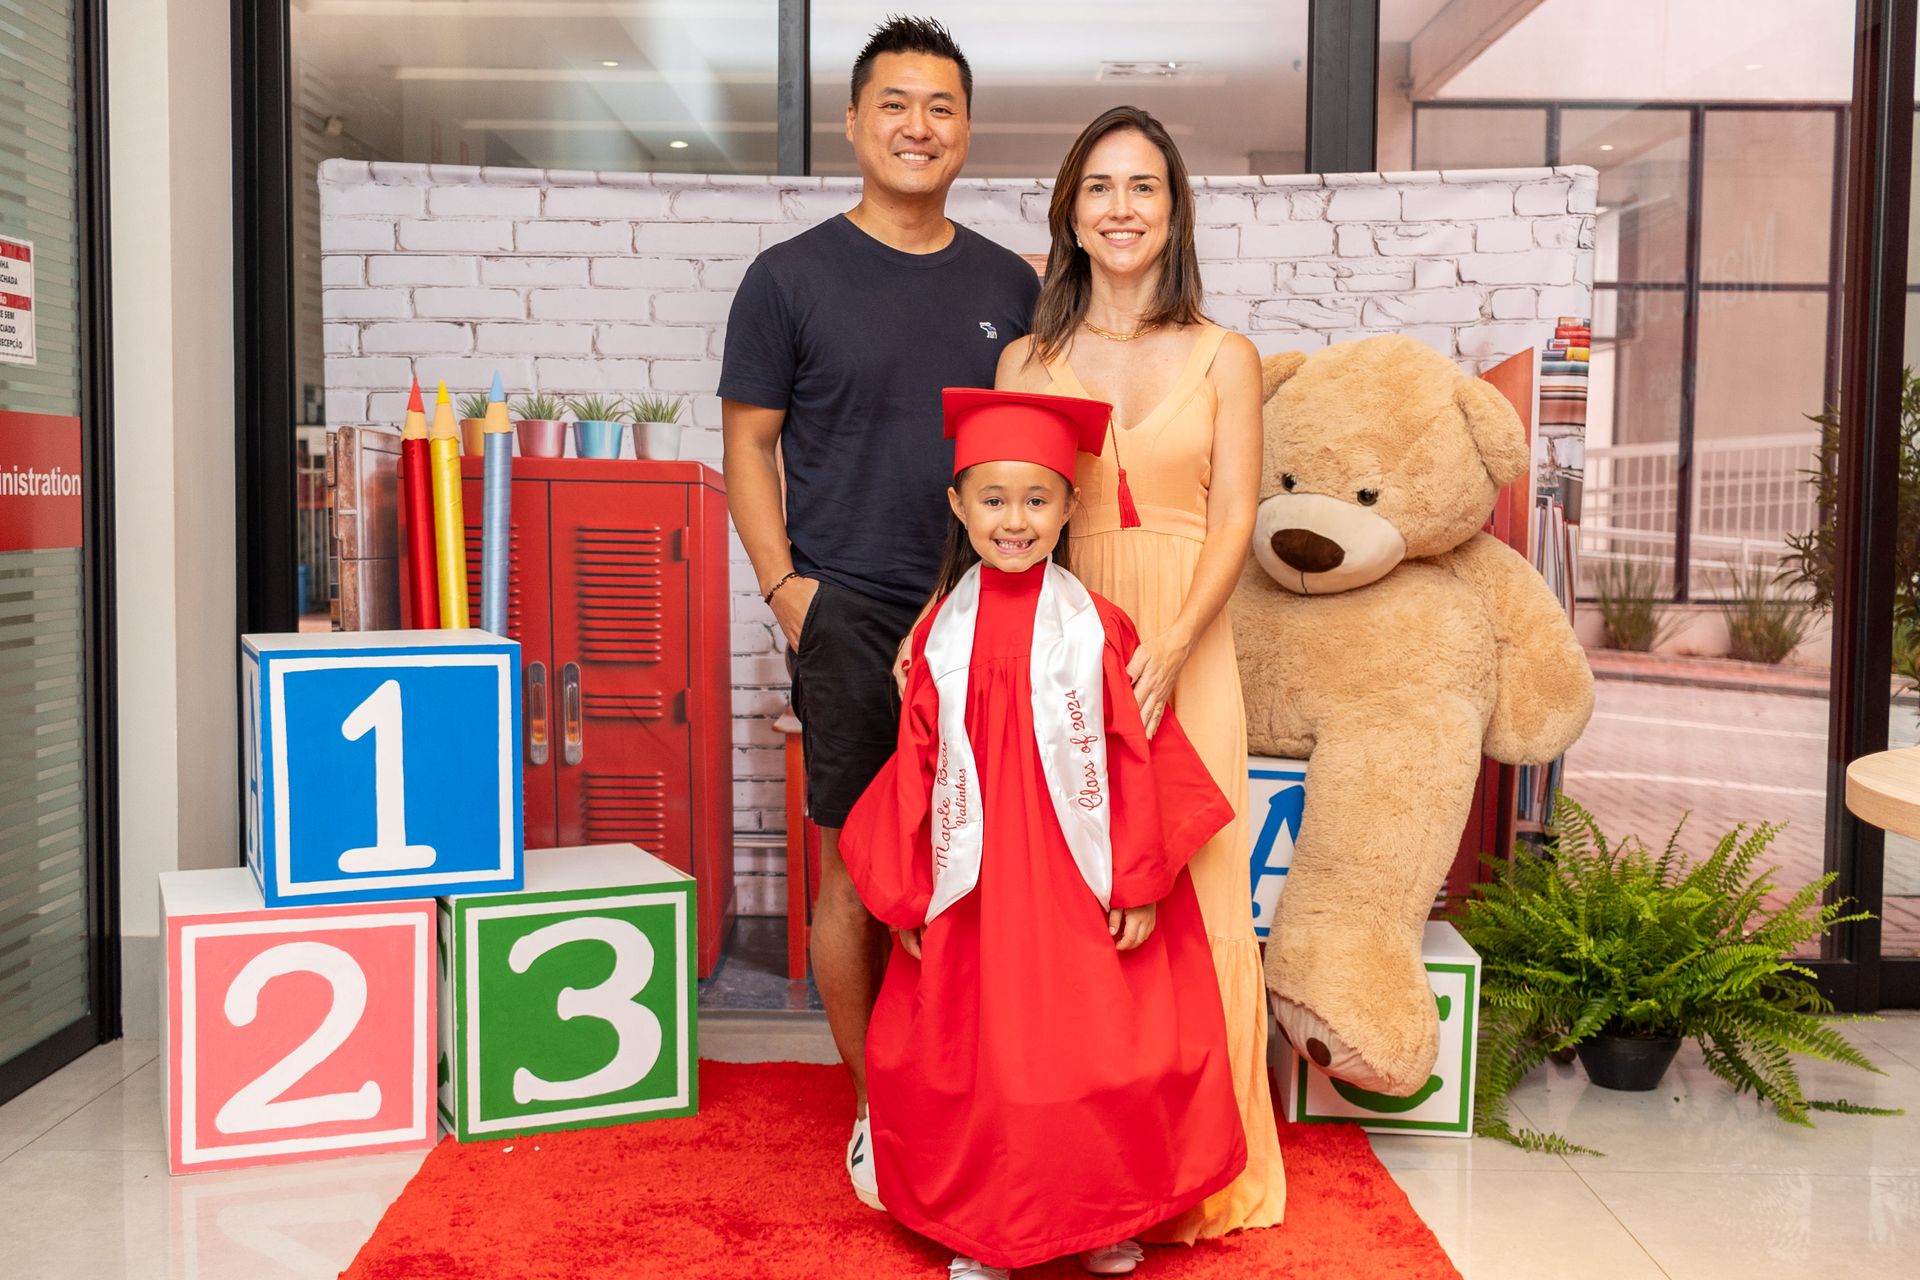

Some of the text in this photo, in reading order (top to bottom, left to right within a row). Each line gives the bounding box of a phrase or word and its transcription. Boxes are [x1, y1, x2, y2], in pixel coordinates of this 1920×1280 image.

[337, 679, 437, 873] 1
[955, 768, 967, 827] Valinhos
[1064, 689, 1103, 812] Class of 2024
[936, 797, 957, 875] Maple
[215, 941, 382, 1134] 2
[508, 917, 662, 1104] 3
